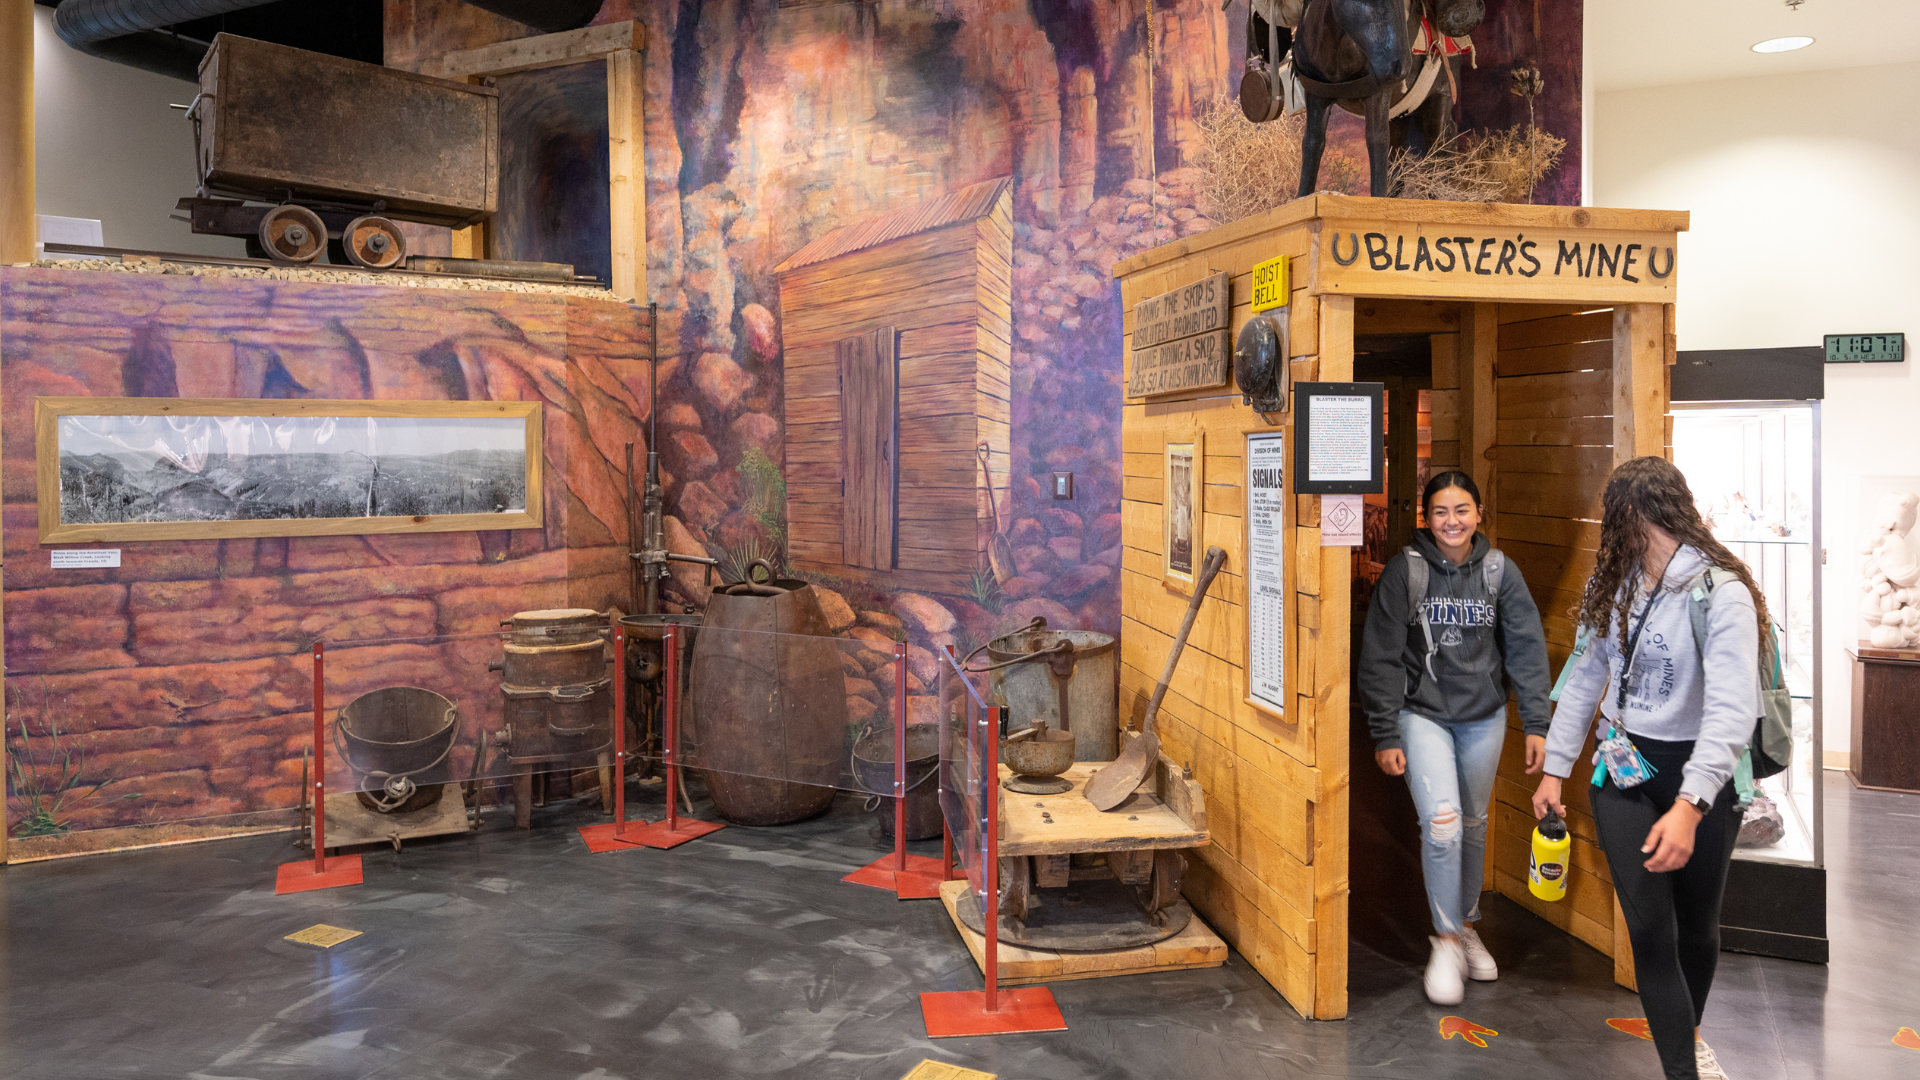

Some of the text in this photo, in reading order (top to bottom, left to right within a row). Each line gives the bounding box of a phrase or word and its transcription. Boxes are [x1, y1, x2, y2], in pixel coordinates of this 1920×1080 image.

[1363, 232, 1642, 284] BLASTER'S MINE
[1254, 262, 1280, 287] HOIST
[1137, 280, 1215, 326] RIDING THE SKIP IS
[1254, 284, 1278, 306] BELL
[1132, 306, 1218, 349] ABSOLUTELY PROHIBITED
[1160, 342, 1183, 367] RIDING
[1185, 341, 1191, 362] A
[1194, 334, 1216, 360] SKIP
[1836, 336, 1886, 353] 11:07
[1147, 372, 1157, 392] SO
[1159, 370, 1168, 390] AT
[1169, 368, 1181, 388] HIS
[1182, 364, 1200, 387] OWN
[1202, 360, 1220, 384] RISK
[1252, 468, 1282, 489] SIGNALS
[1652, 633, 1669, 652] OF
[1658, 657, 1674, 697] MINES
